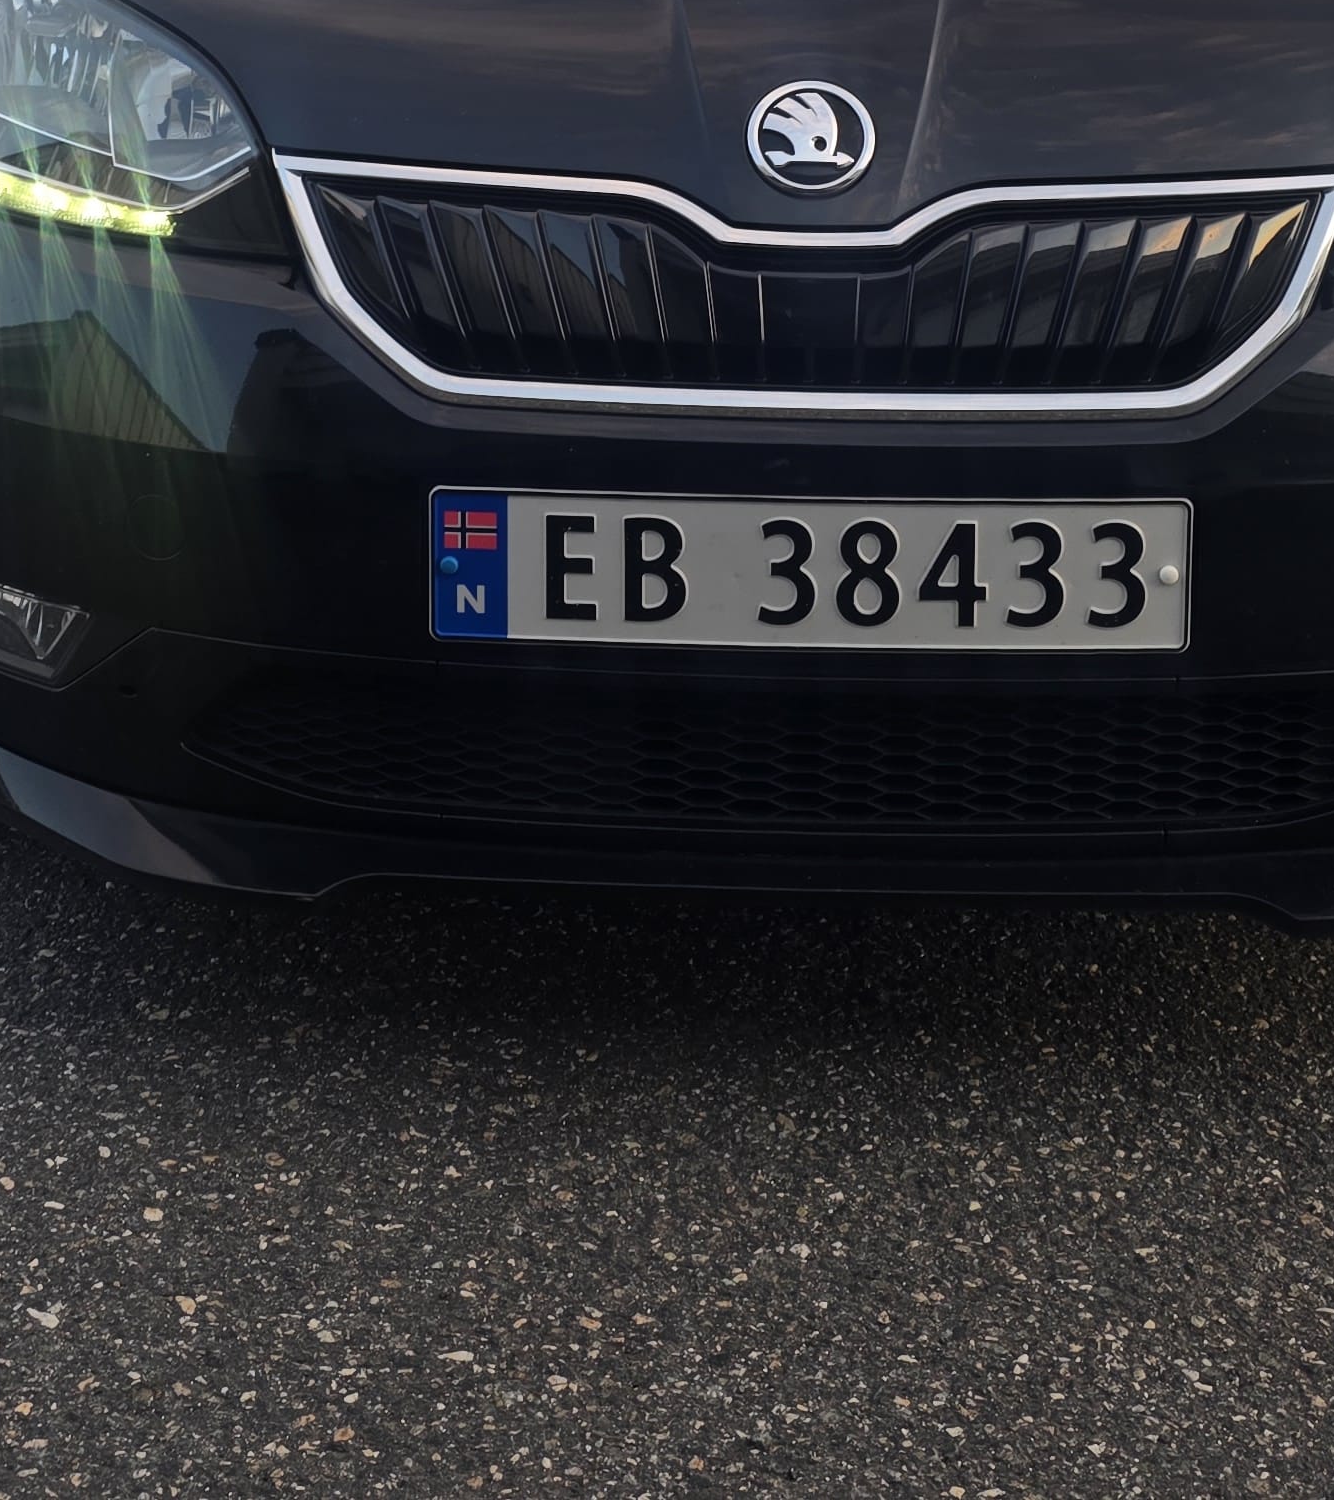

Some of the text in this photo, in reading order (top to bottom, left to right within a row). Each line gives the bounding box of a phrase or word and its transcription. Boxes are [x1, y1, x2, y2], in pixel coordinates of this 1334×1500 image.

[456, 584, 485, 613] N
[545, 514, 1146, 629] EB 38433
